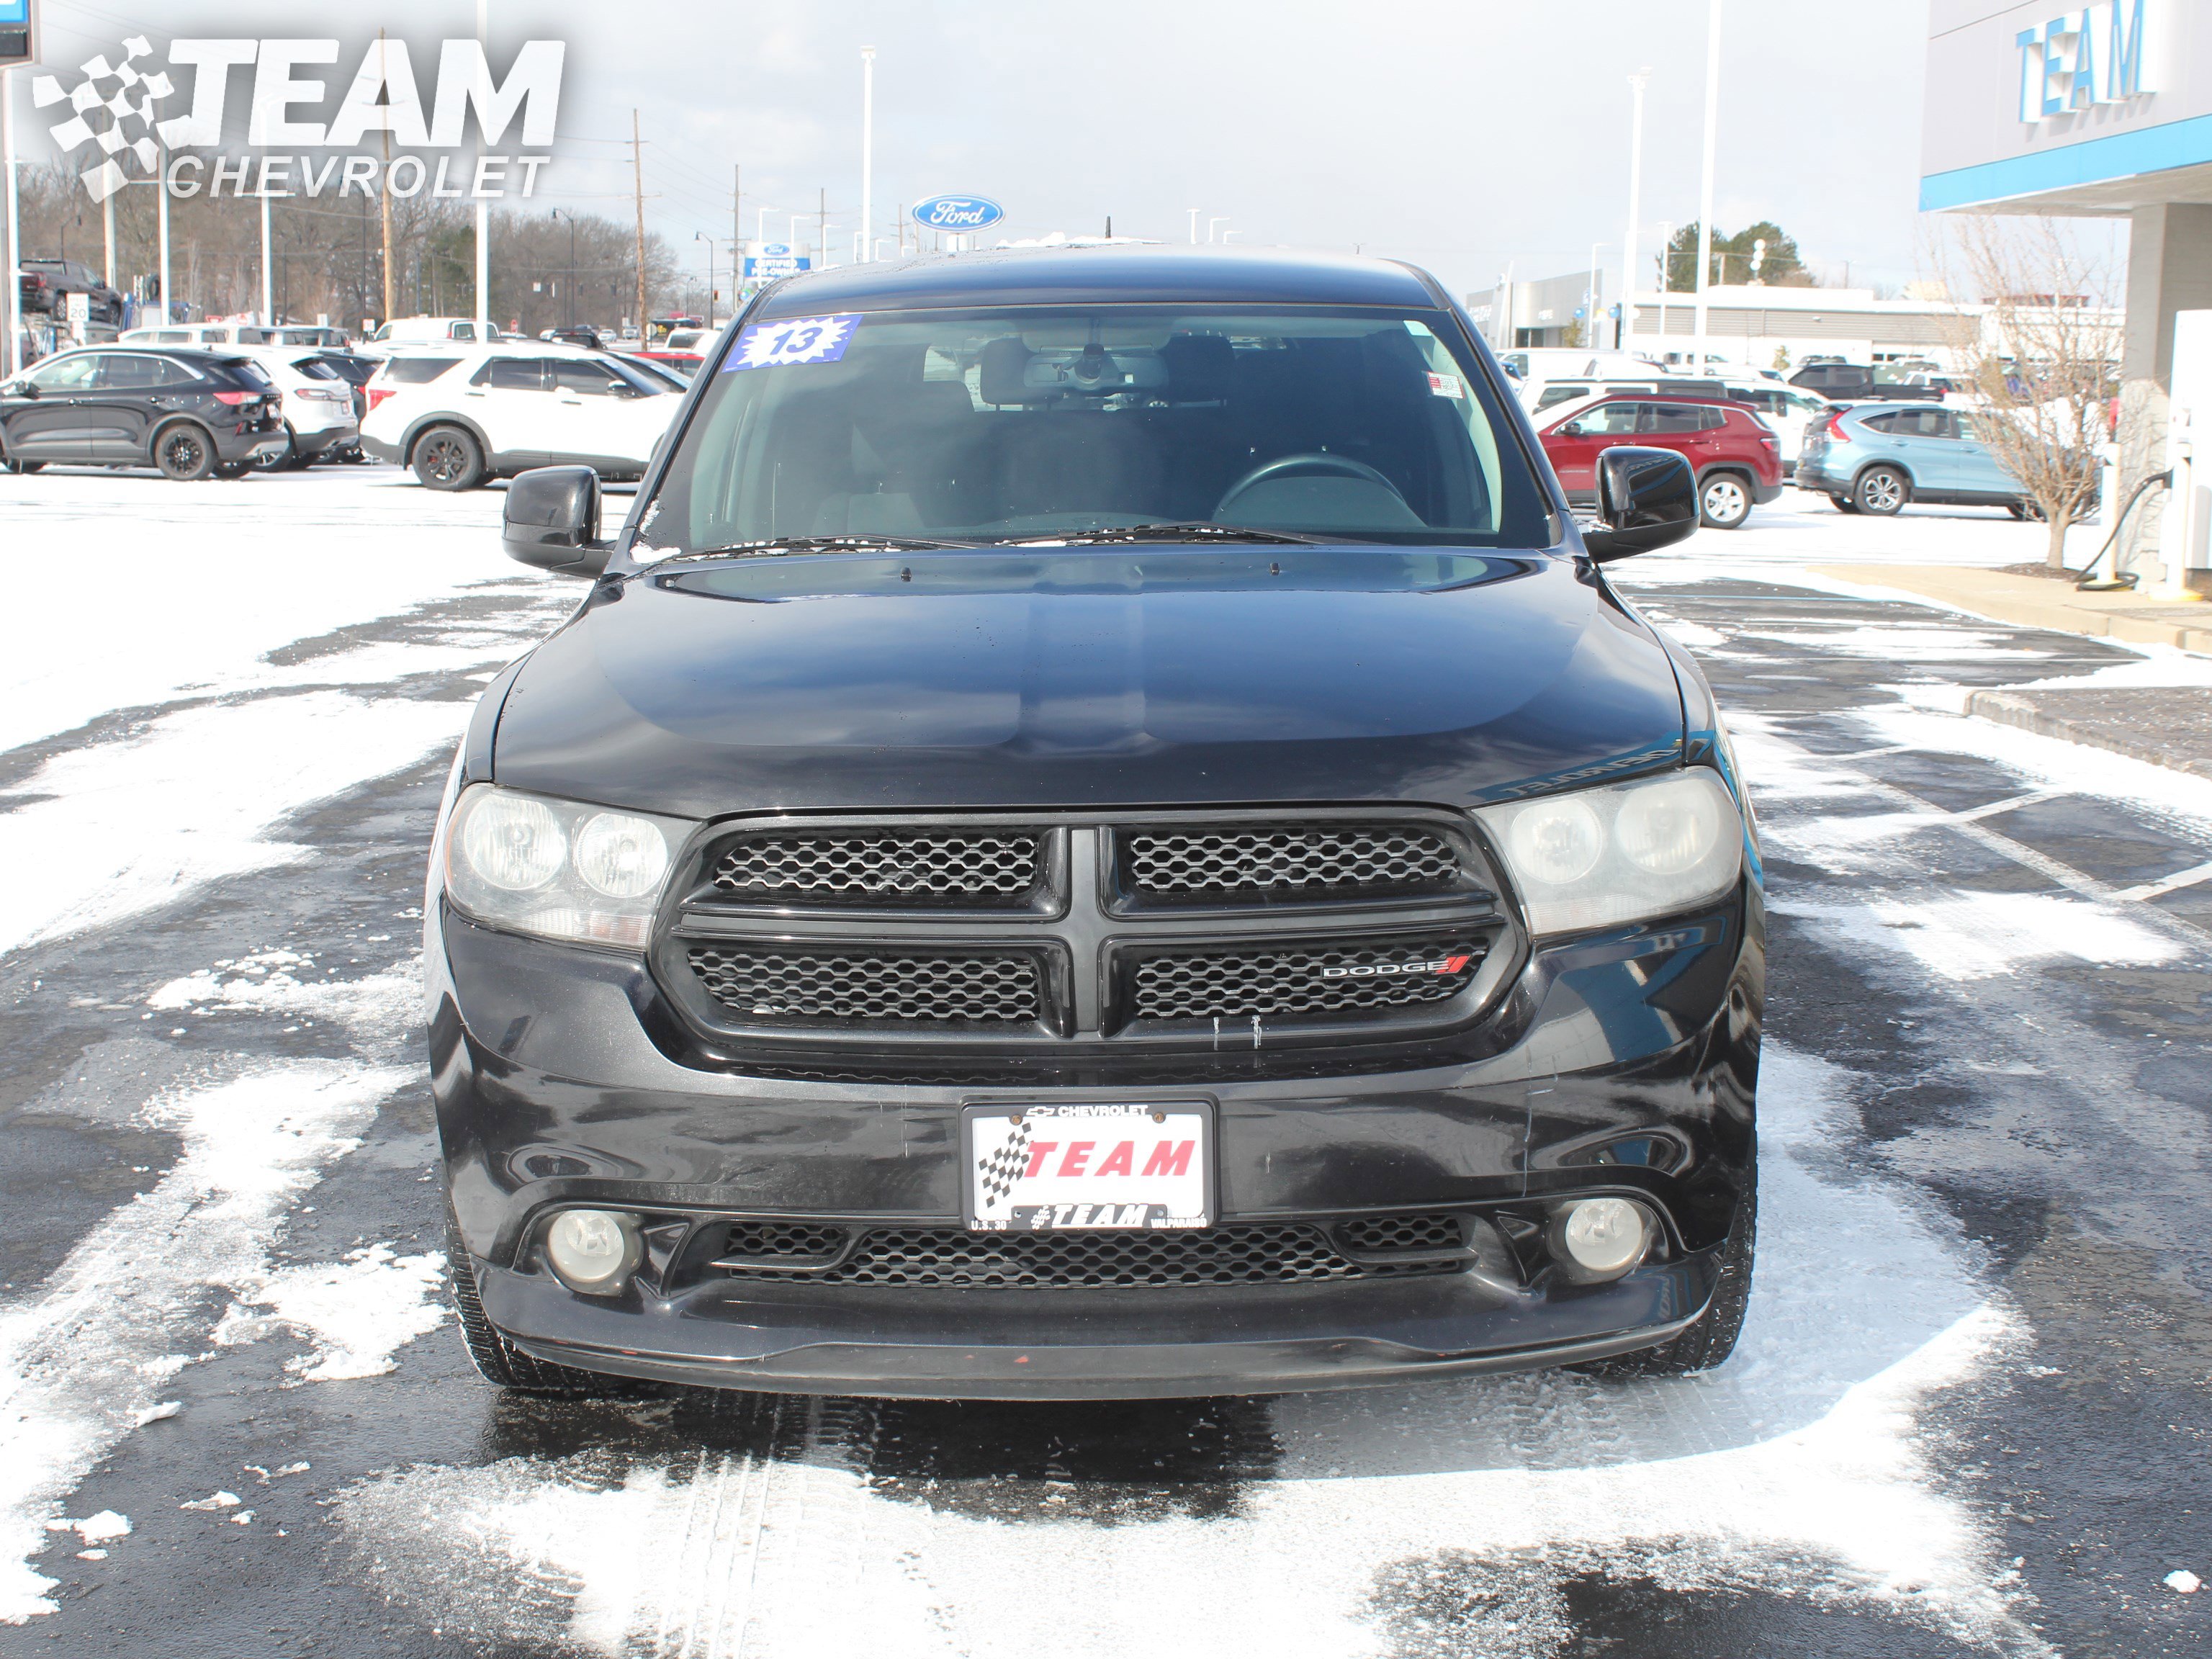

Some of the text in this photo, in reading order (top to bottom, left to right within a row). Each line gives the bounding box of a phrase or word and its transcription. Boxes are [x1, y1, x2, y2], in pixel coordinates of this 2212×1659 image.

[2015, 0, 2157, 123] TEAM
[930, 201, 986, 224] Ford
[751, 267, 801, 277] PE-OWN
[71, 308, 86, 318] 20
[770, 327, 824, 356] 13
[1323, 960, 1449, 978] DODGE
[1057, 1105, 1148, 1117] CHEVROLET
[1023, 1140, 1196, 1177] TEAM
[1052, 1203, 1148, 1226] TEAM
[1151, 1218, 1208, 1229] VALPARAISO
[971, 1220, 1007, 1231] U.S. 30
